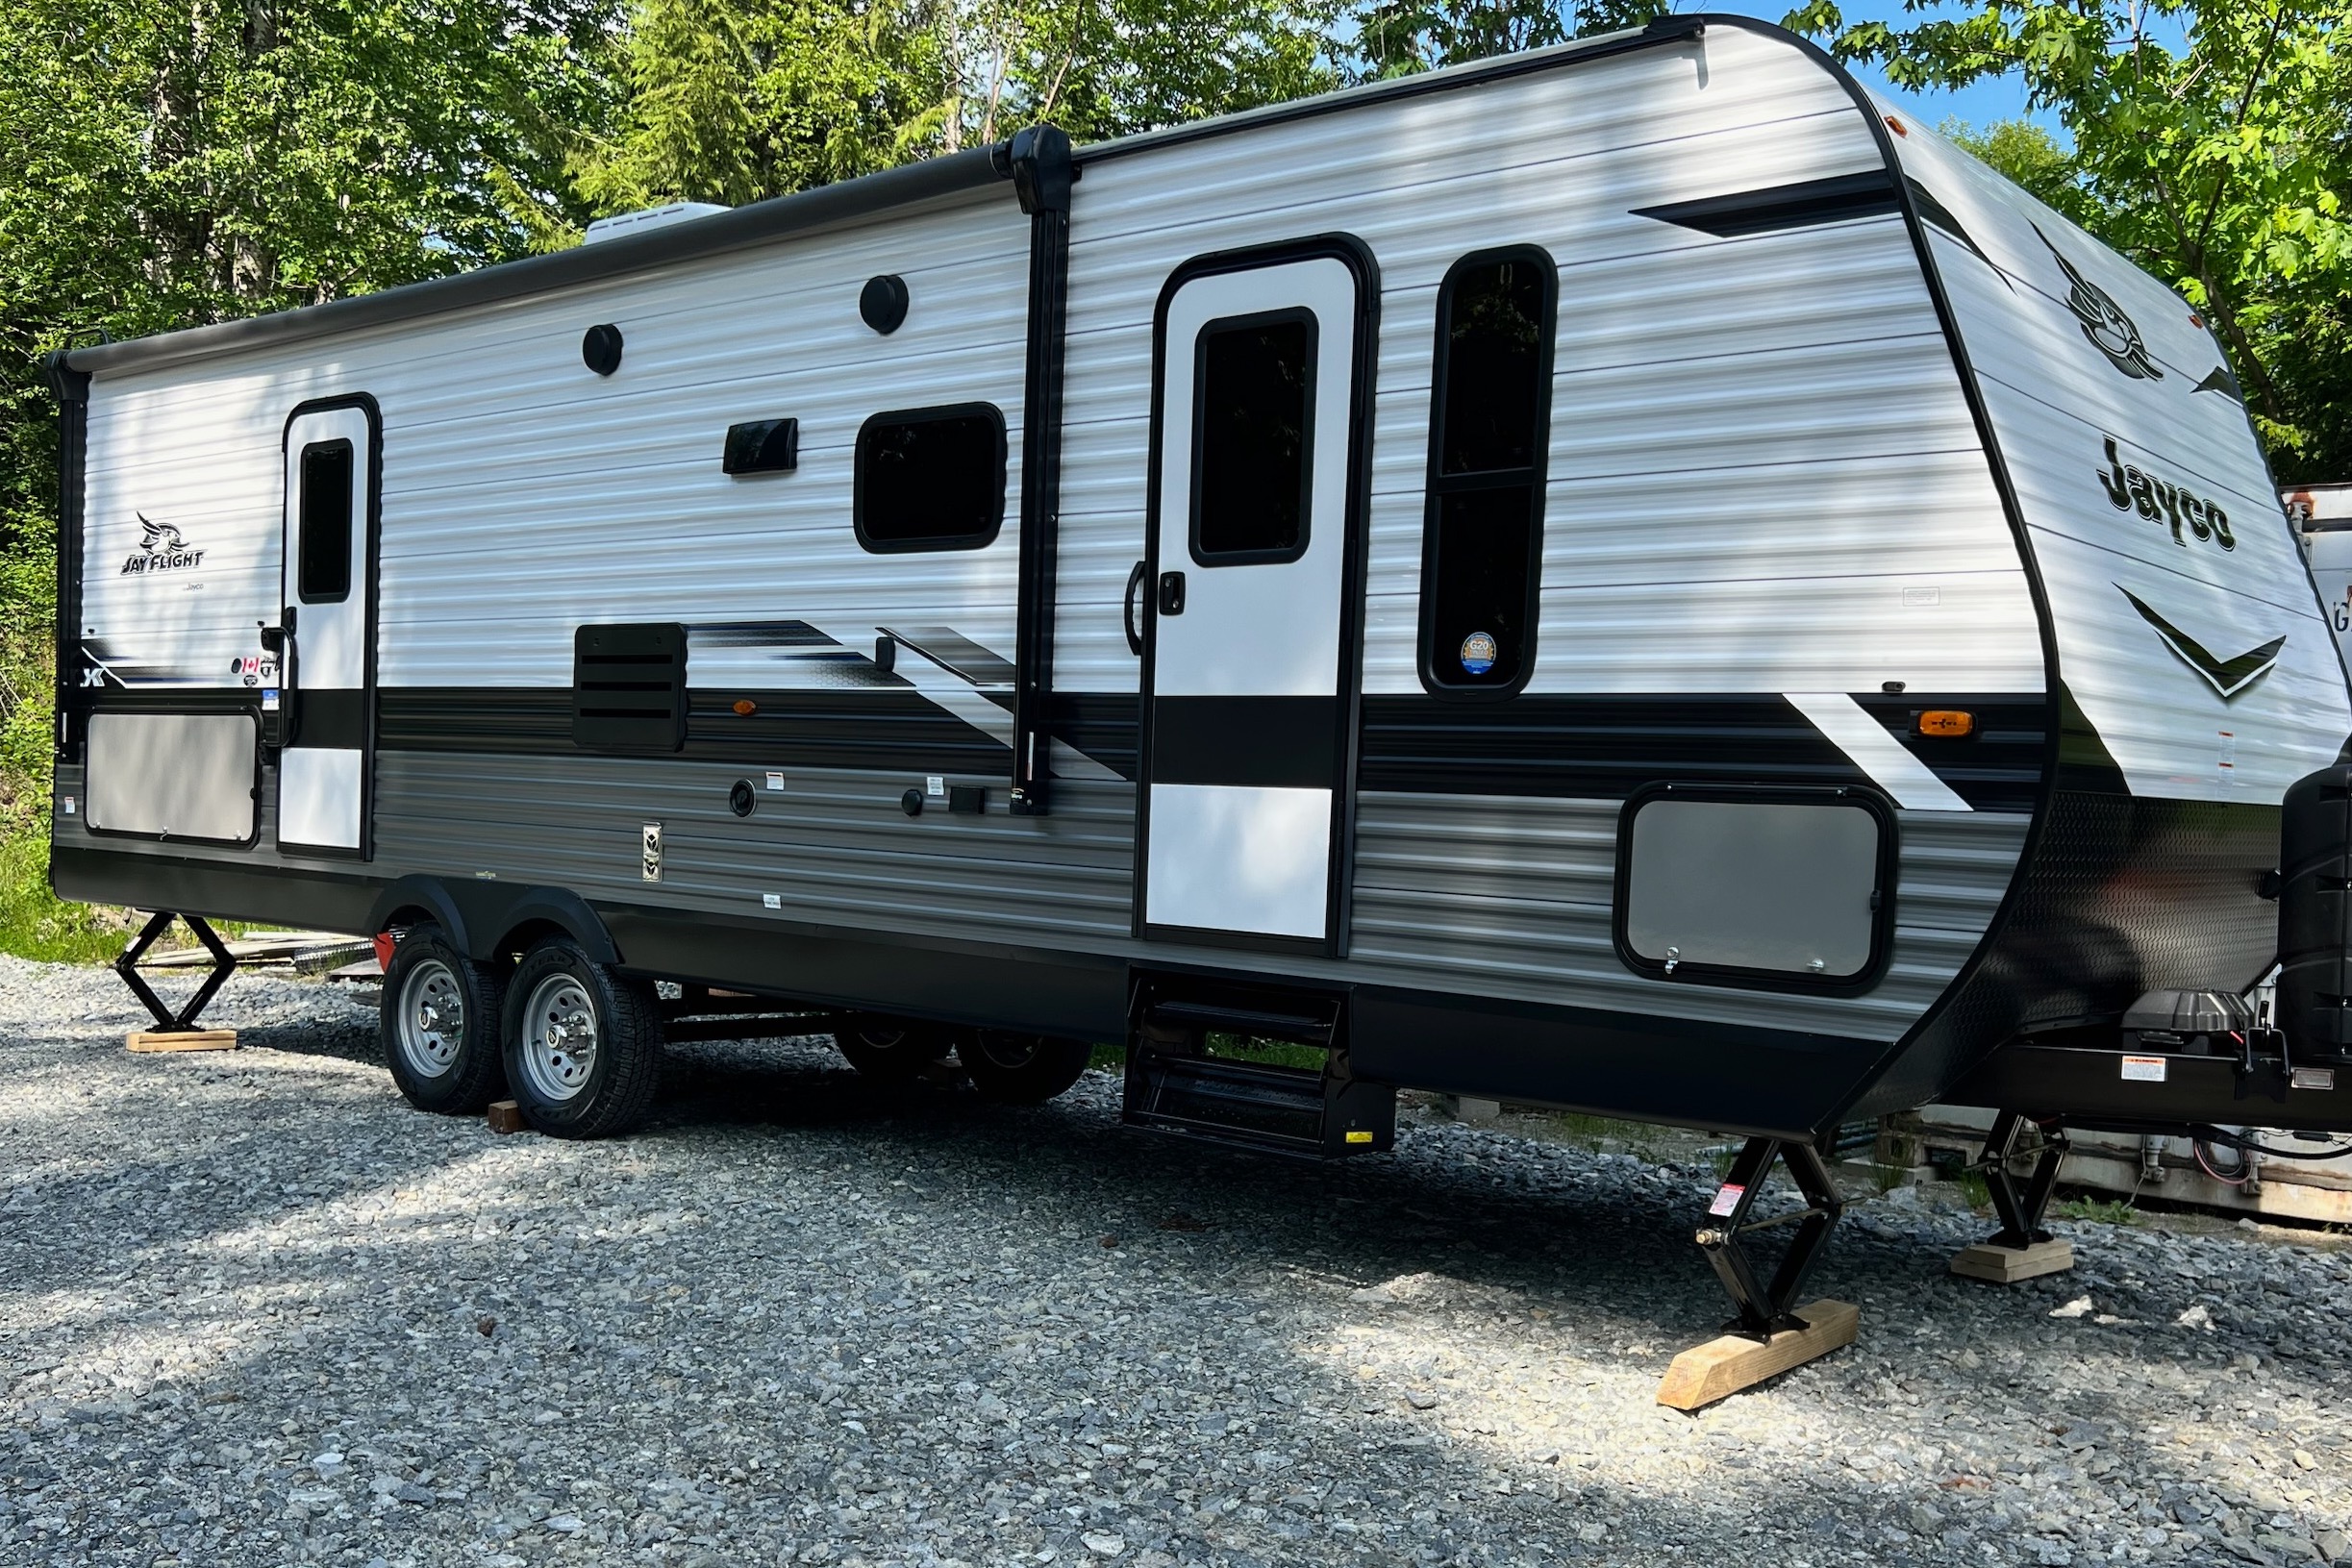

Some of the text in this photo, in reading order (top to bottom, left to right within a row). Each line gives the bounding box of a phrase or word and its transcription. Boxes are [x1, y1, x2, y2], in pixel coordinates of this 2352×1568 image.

[2095, 434, 2237, 552] Jayco
[120, 550, 207, 575] JAY FLIGHT
[1469, 640, 1489, 651] G20
